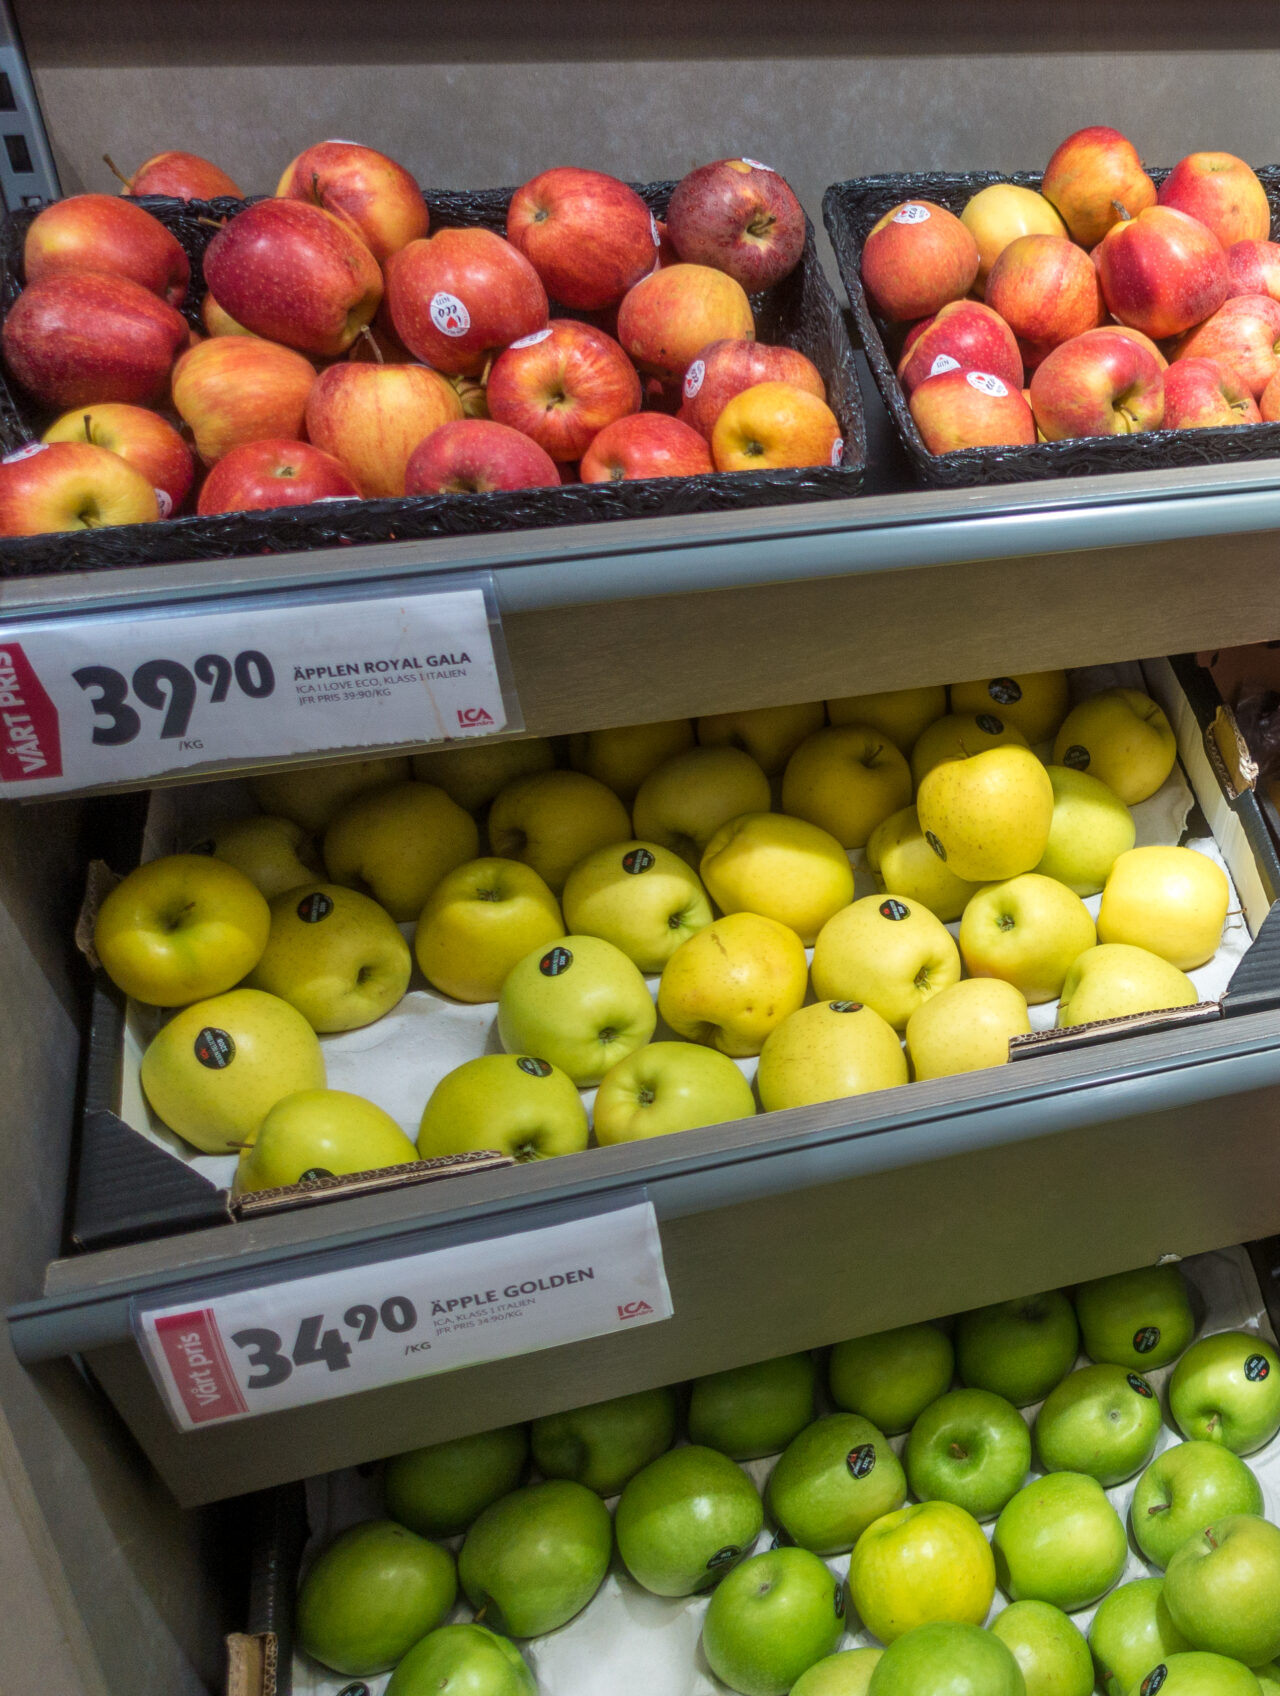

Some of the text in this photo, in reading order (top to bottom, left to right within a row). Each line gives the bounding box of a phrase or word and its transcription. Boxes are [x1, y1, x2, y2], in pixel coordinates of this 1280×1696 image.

[293, 651, 473, 682] ÄPPLEN ROYAL GALA
[296, 684, 316, 694] ICA
[323, 680, 353, 692] LOVE
[383, 673, 418, 685] KLASS
[426, 668, 468, 681] ITALIEN
[317, 692, 341, 703] PRIS
[456, 707, 494, 724] ICA
[3, 712, 48, 774] VÅRT
[178, 739, 205, 752] /KG
[430, 1266, 596, 1318] ÄPPLE GOLDEN
[456, 1309, 489, 1323] KLASS
[496, 1297, 537, 1313] ITALIEN
[616, 1299, 653, 1317] ICA
[453, 1320, 476, 1332] PRIS
[180, 1332, 213, 1366] pris
[403, 1341, 433, 1356] /KG
[191, 1362, 221, 1407] Vårt
